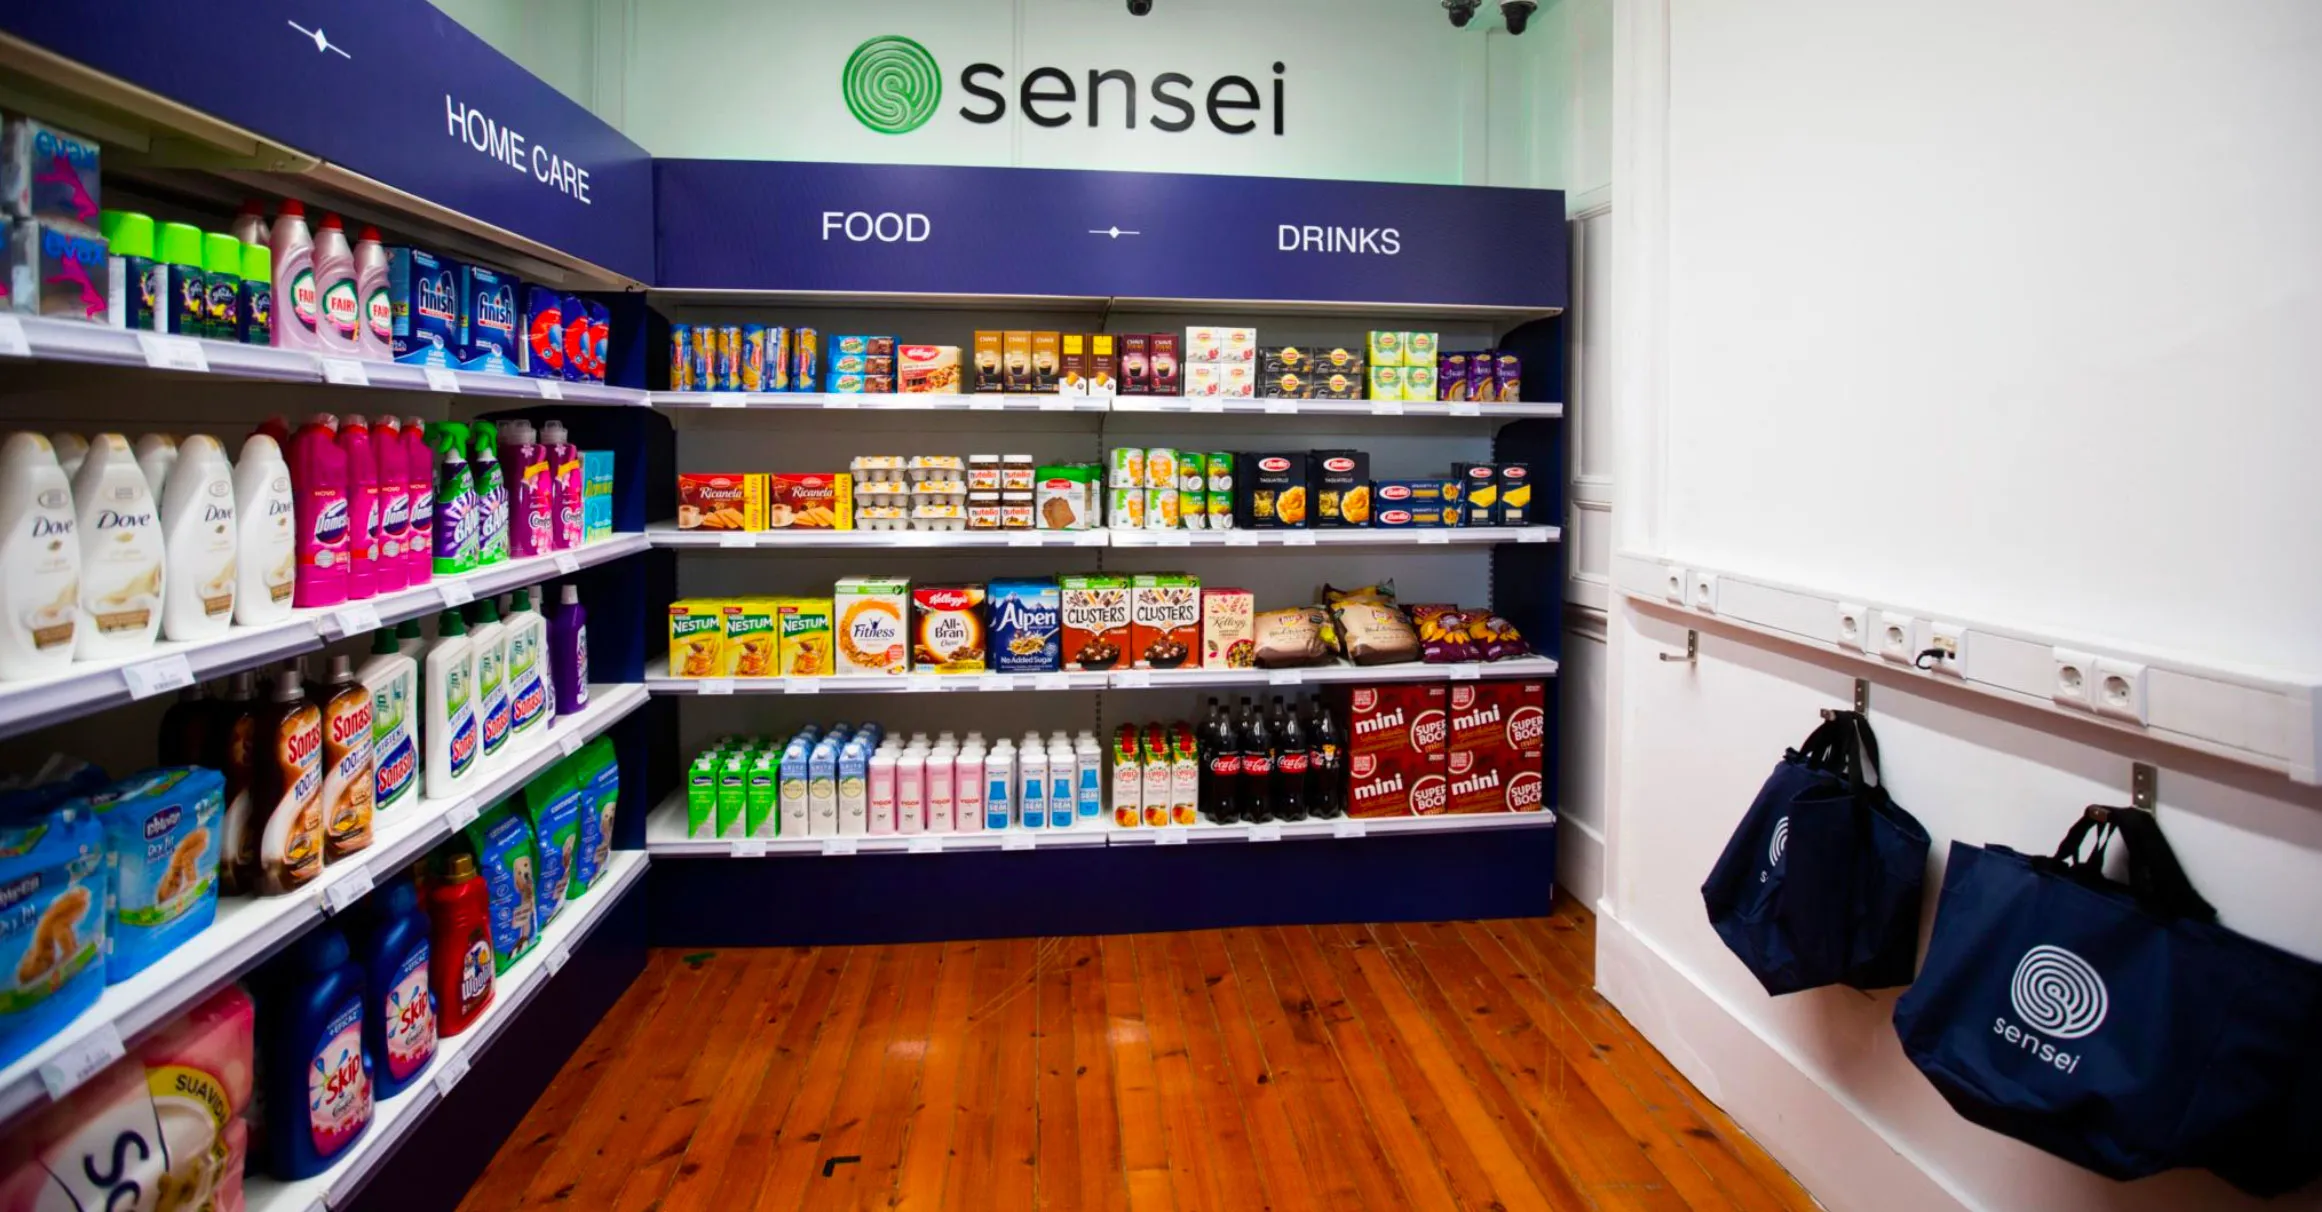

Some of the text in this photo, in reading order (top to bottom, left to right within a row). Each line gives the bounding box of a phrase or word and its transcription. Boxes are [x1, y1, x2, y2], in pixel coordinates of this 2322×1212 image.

[959, 61, 1286, 136] sensei
[445, 94, 591, 205] HOME CARE
[822, 211, 931, 242] FOOD
[1278, 223, 1401, 255] DRINKS
[298, 288, 315, 301] FAIR
[419, 279, 454, 314] finish
[479, 293, 512, 327] finish
[969, 470, 997, 479] nutella
[1004, 470, 1032, 479] nutella
[205, 503, 234, 523] Dove
[269, 499, 293, 516] Dove
[972, 508, 998, 516] nutella
[1004, 507, 1031, 516] nutella
[32, 516, 74, 538] Dove
[96, 509, 151, 530] Dove
[996, 602, 1056, 632] Alpen
[1067, 606, 1126, 624] CLUSTERS
[1136, 605, 1194, 622] CLUSTERS
[672, 617, 721, 633] NESTUM
[726, 617, 773, 633] NESTUM
[782, 616, 829, 632] NESTUM
[853, 623, 895, 638] Fitness
[935, 626, 964, 638] Bran
[940, 618, 961, 629] All-
[1010, 655, 1034, 663] Added
[1034, 656, 1053, 665] Sugar
[1355, 707, 1405, 735] mini
[1453, 703, 1500, 731] mini
[1511, 716, 1544, 732] SUPER
[1514, 726, 1544, 741] BOCK
[378, 749, 414, 793] Sonasol
[1354, 773, 1403, 800] mini
[1451, 769, 1500, 796] mini
[1994, 1014, 2081, 1075] sensei
[326, 1053, 360, 1105] skip
